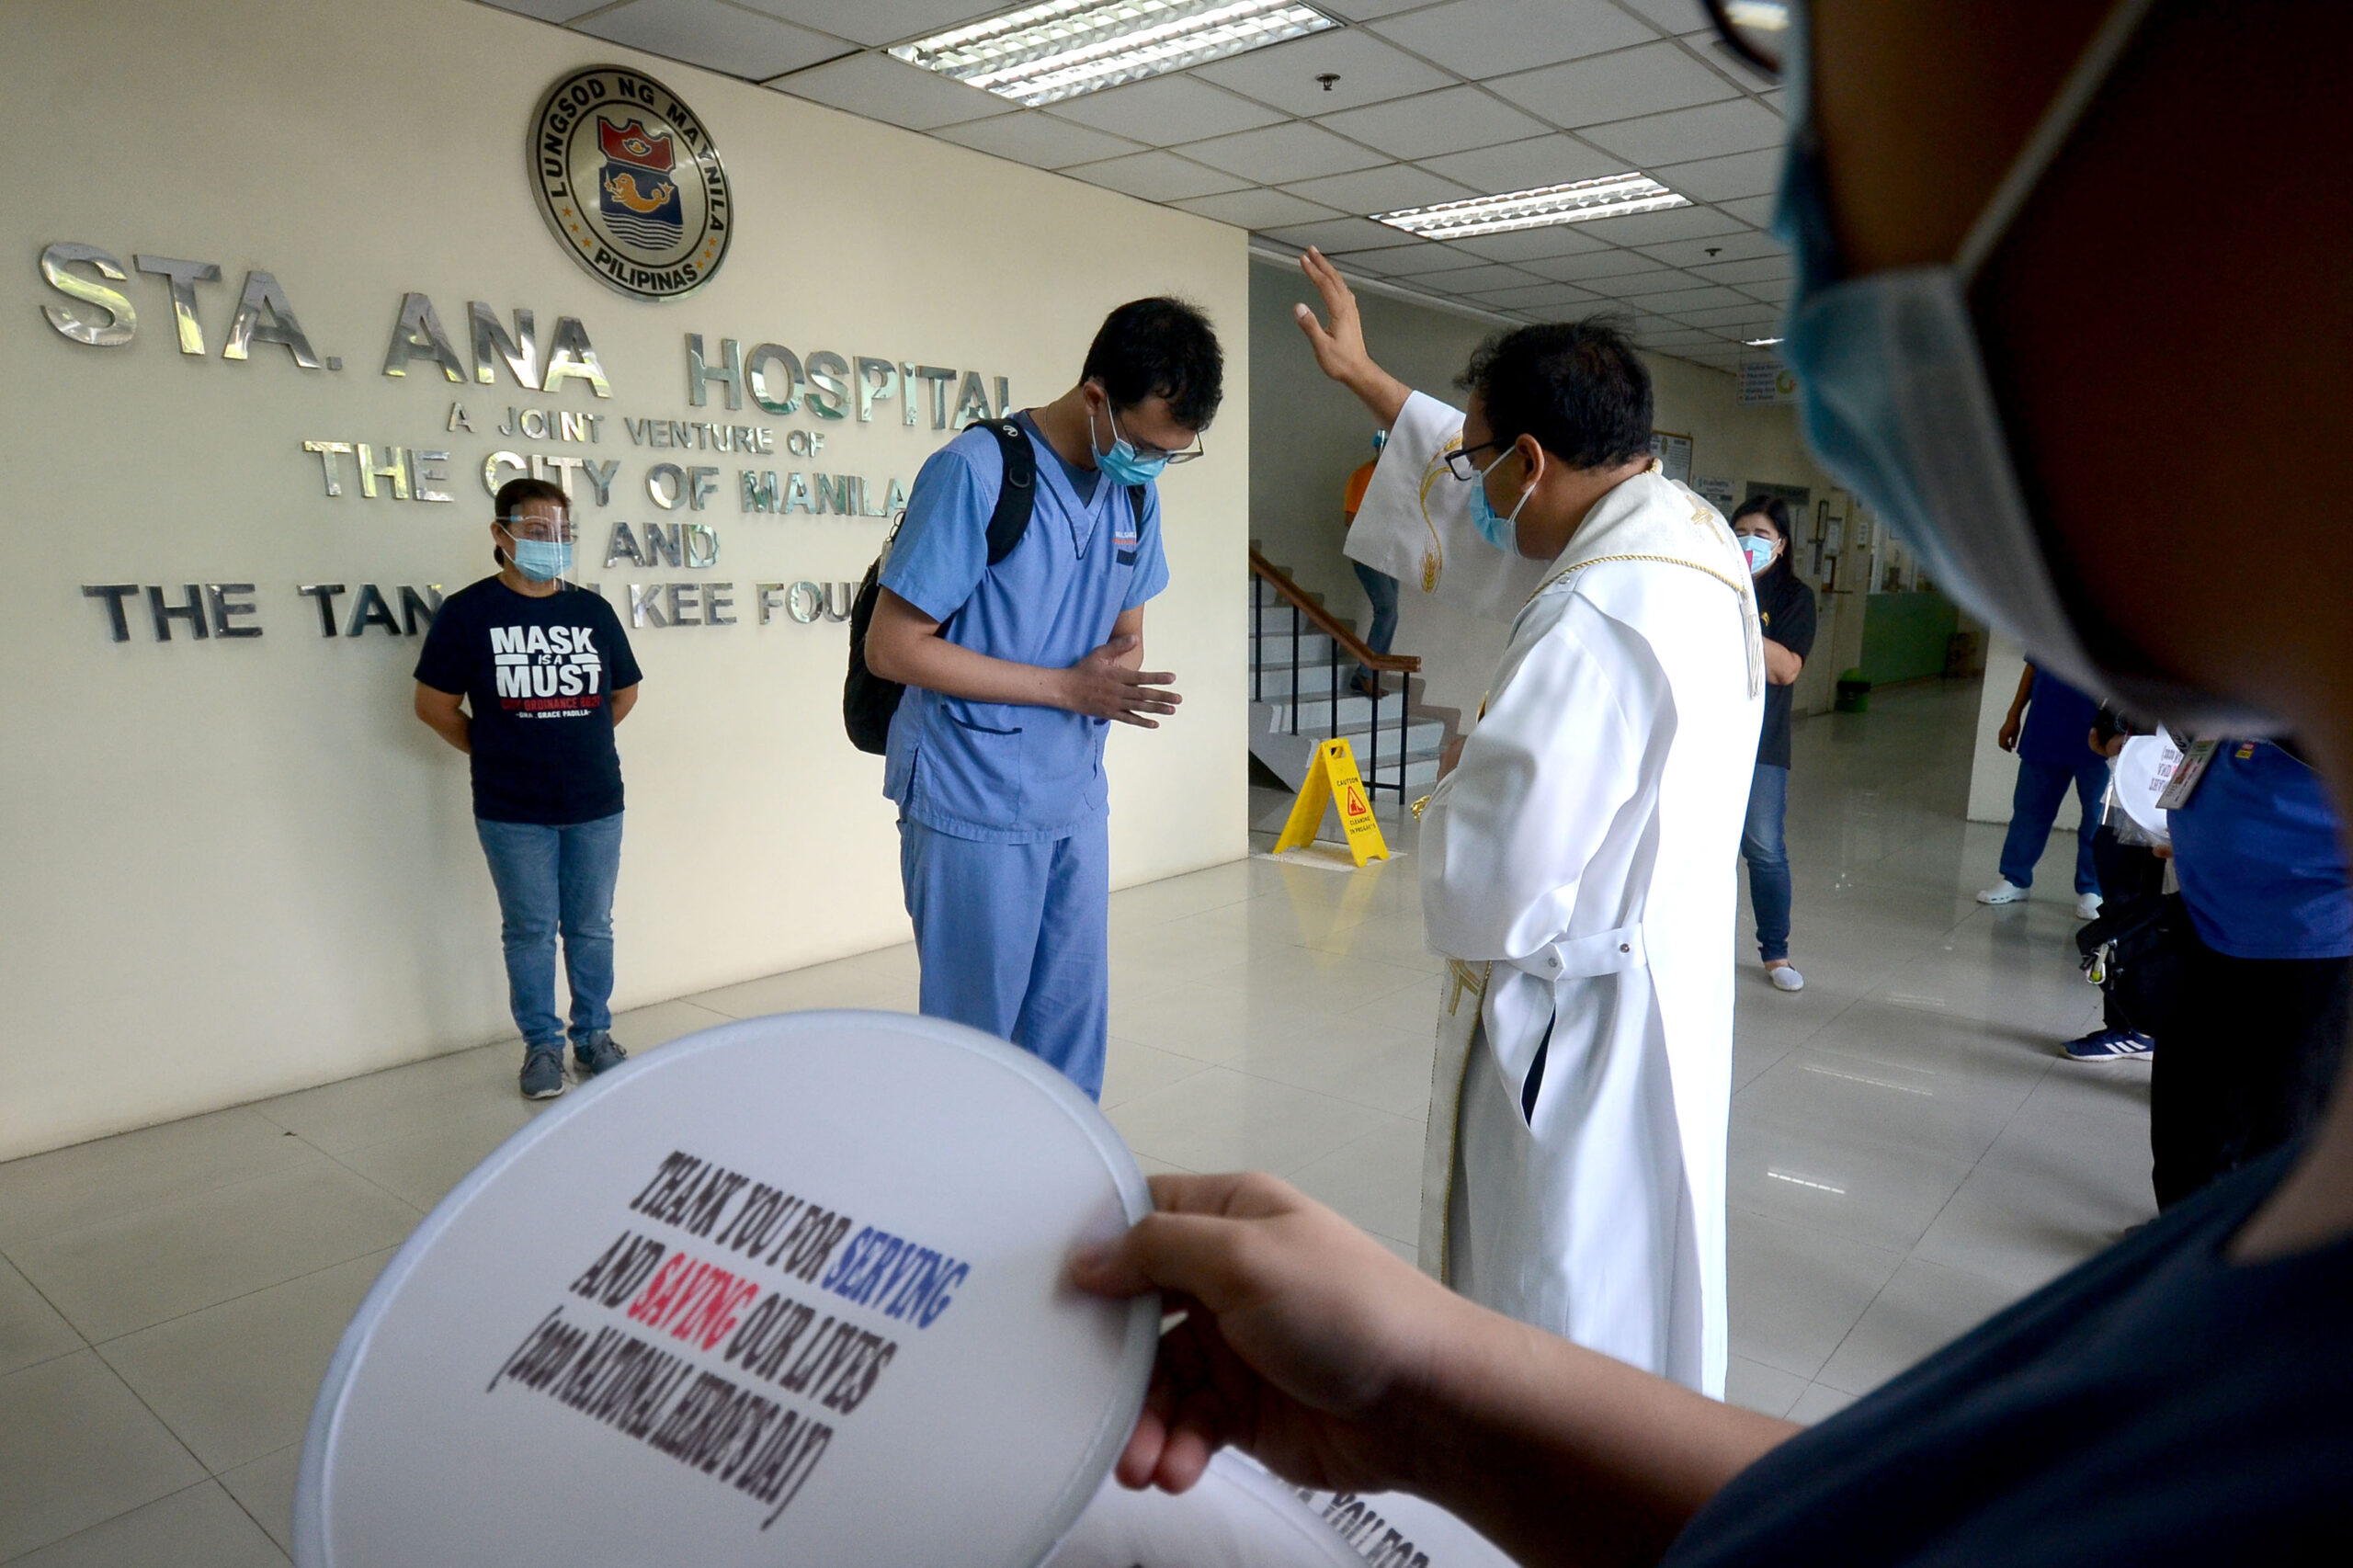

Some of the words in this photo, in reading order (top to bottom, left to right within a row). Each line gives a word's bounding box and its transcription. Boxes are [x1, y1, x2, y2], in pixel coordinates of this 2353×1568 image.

[545, 78, 606, 198] LUNGSOD
[618, 76, 654, 106] NG
[665, 104, 725, 232] MAYNILA
[594, 247, 698, 290] PILIPINAS
[39, 242, 343, 370] STA.
[382, 292, 612, 398] ANA
[448, 402, 477, 434] A
[499, 407, 604, 443] JOINT
[624, 417, 774, 455] VENTURE
[787, 429, 824, 458] OF
[302, 440, 455, 503] THE
[480, 449, 620, 506] CITY
[645, 462, 720, 510] OF
[738, 470, 909, 517] MANILA
[603, 522, 721, 569] AND
[81, 583, 263, 642] THE
[296, 584, 448, 638] TAN
[627, 582, 737, 629] KEE
[756, 581, 861, 624] FOU
[490, 626, 598, 653] MASK
[538, 654, 551, 665] IS
[553, 654, 563, 665] A
[496, 664, 602, 698] MUST
[524, 697, 578, 711] ORDINANCE
[538, 710, 562, 719] GRACE
[1336, 777, 1358, 787] CAUTION
[630, 1150, 749, 1237] THANK
[715, 1183, 804, 1258] YOU
[765, 1203, 852, 1284] FOR
[821, 1226, 971, 1329] SERVING
[569, 1230, 665, 1308] AND
[627, 1252, 759, 1351] SAVING
[723, 1293, 816, 1381] OUR
[779, 1316, 897, 1415] LIVES
[551, 1325, 694, 1439] NATIONAL
